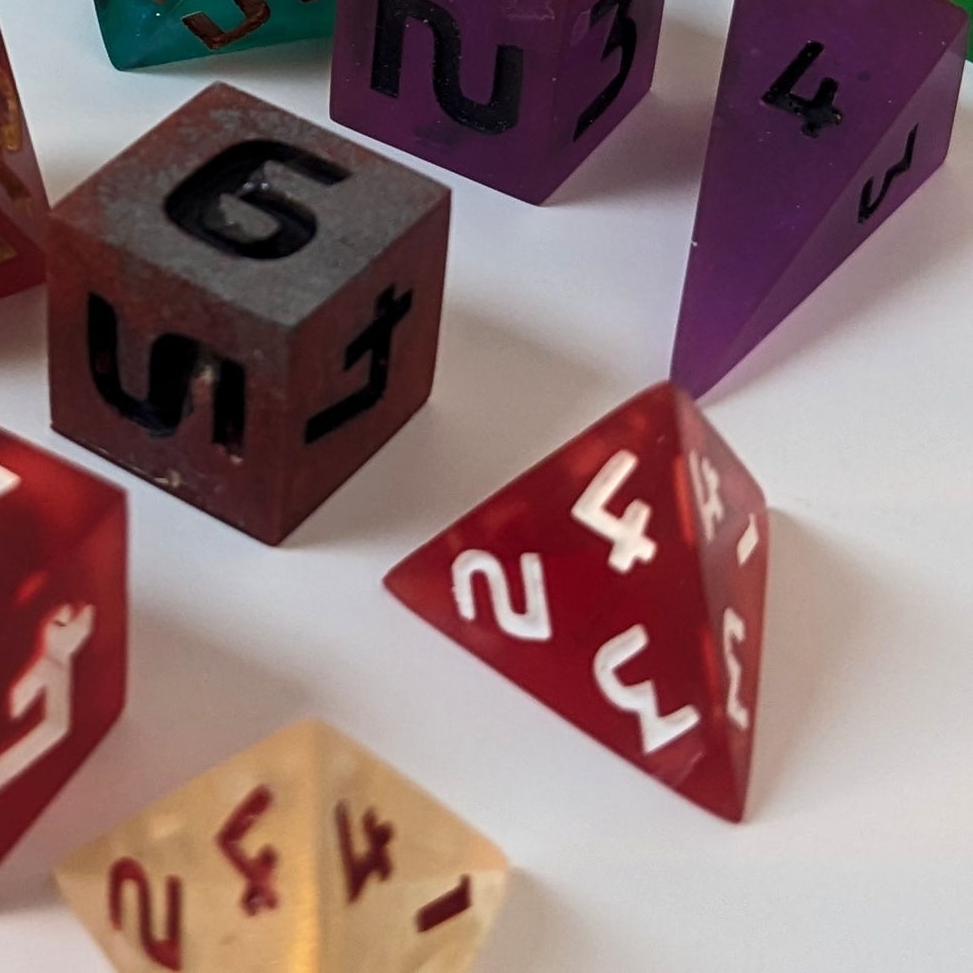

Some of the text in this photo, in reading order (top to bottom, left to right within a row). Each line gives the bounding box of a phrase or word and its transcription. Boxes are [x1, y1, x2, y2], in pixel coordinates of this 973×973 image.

[760, 38, 844, 139] 4
[163, 138, 354, 261] 6
[570, 448, 659, 574] 4
[449, 547, 554, 643] 2
[592, 623, 702, 756] 3
[333, 797, 396, 905] 4
[107, 855, 183, 972] 2
